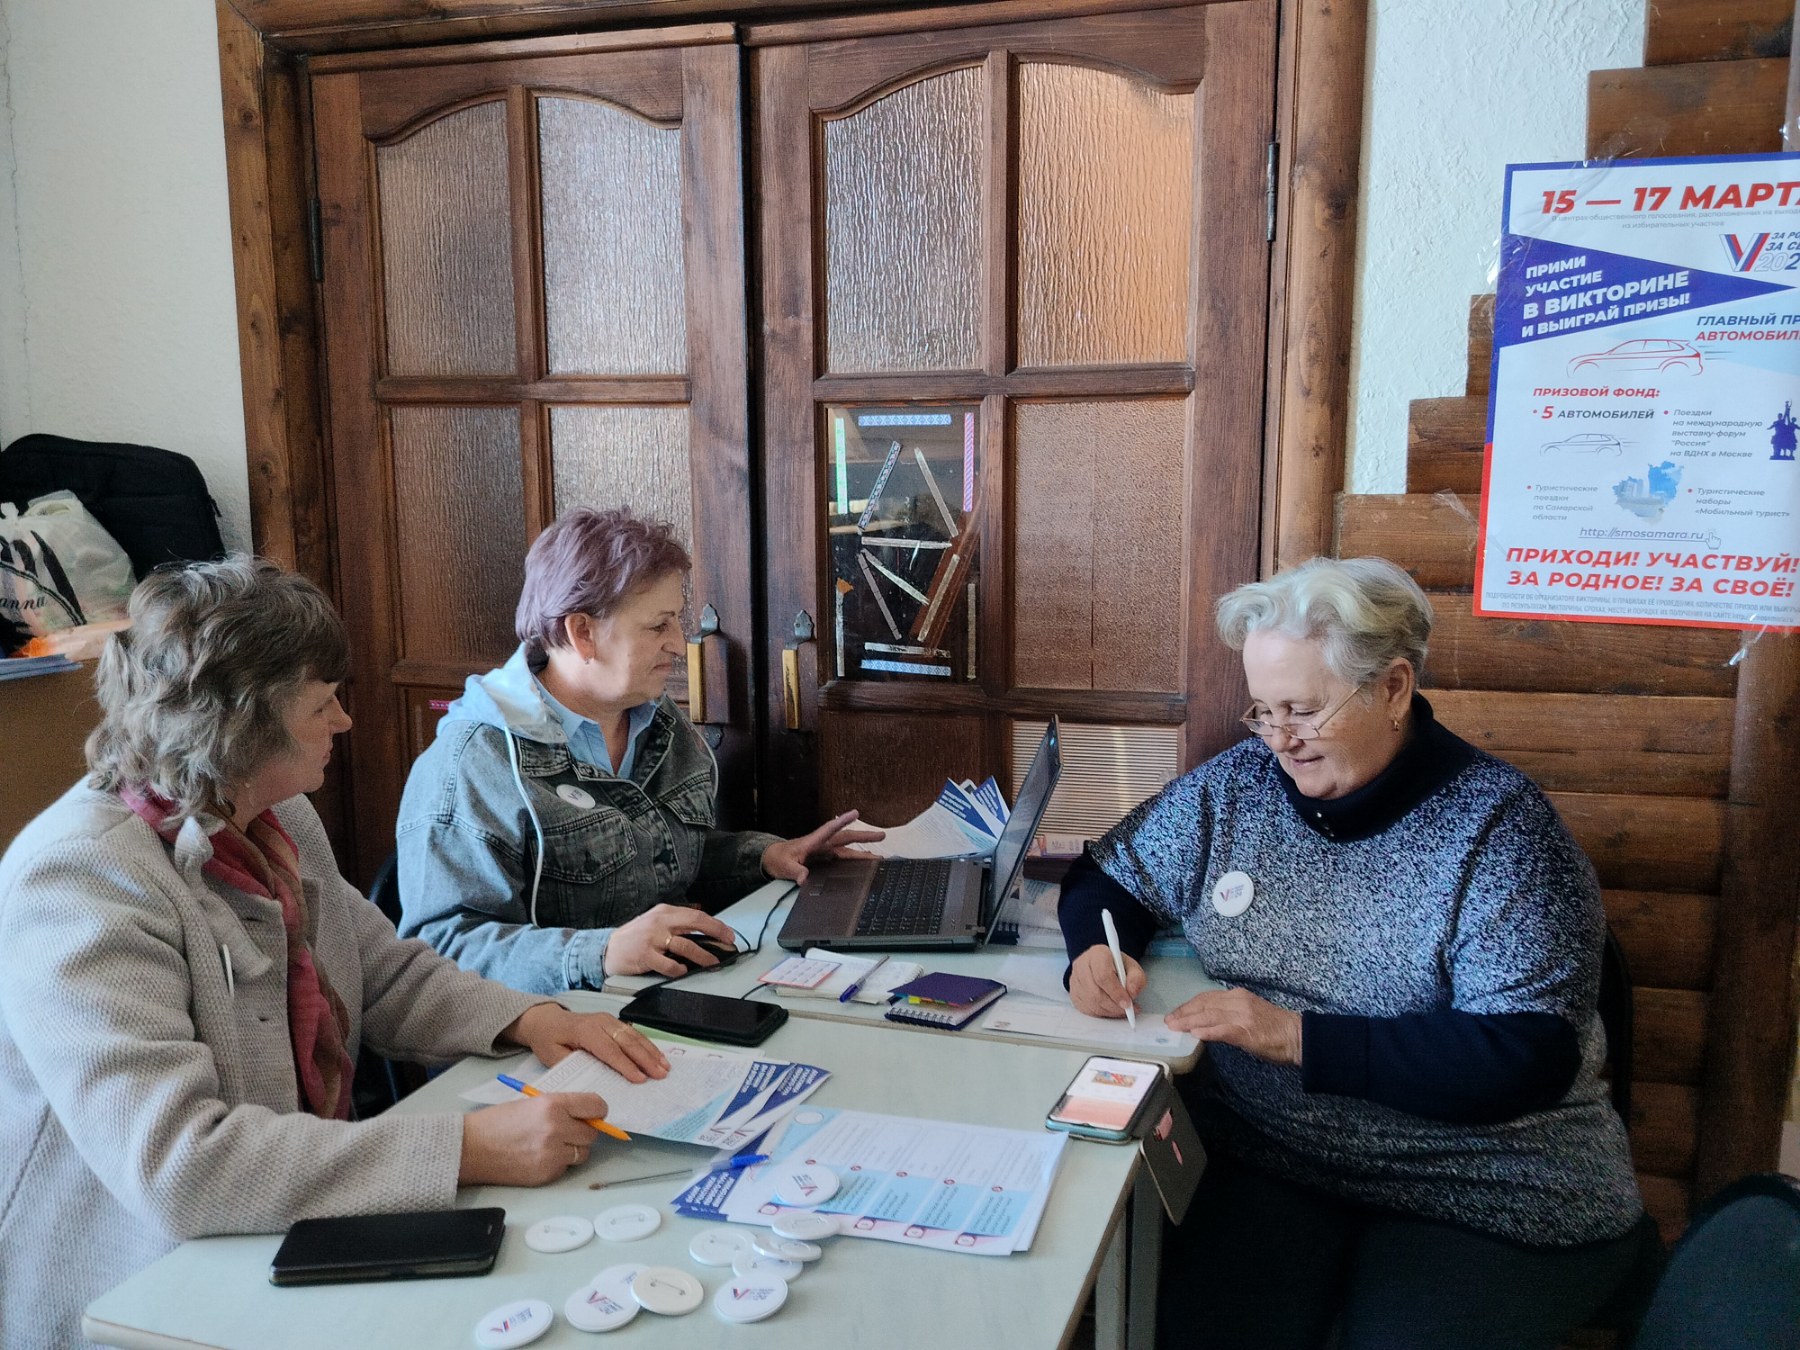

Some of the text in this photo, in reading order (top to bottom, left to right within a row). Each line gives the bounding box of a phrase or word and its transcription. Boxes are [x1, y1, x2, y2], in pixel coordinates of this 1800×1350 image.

[1541, 189, 1577, 214] 15
[1633, 186, 1672, 212] 17
[1679, 181, 1800, 210] МАРТ
[1771, 232, 1786, 240] ЗА
[1765, 242, 1784, 251] ЗА
[1526, 255, 1586, 279] ПРИМИ
[1525, 270, 1603, 297] УЧАСТИЕ
[1523, 270, 1690, 320] В ВИКТОРИНЕ
[1521, 292, 1691, 338] И ВЫИГРАЙ ПРИЗЫ!
[1696, 312, 1777, 326] ГЛАВНЫЙ
[1695, 330, 1800, 342] АВТОМОБИЛ
[1532, 385, 1660, 398] ПРИЗОВОЙ ФОНД:
[1541, 405, 1655, 420] 5 АВТОМОБИЛЕЙ
[1673, 408, 1712, 417] Поездки
[1686, 419, 1763, 429] международную
[1671, 429, 1747, 439] выставку-форум
[1683, 450, 1709, 458] ВДНХ
[1718, 450, 1753, 458] Москве
[1535, 484, 1599, 493] Туристические
[1697, 487, 1766, 497] Туристические
[1533, 494, 1570, 502] поездки
[1695, 497, 1732, 506] наборы
[1545, 503, 1594, 513] Самарской
[1532, 513, 1568, 521] области
[1580, 527, 1704, 540] http://smosamara.ru
[1505, 547, 1800, 573] ПРИХОДИ! УЧАСТВУЙ!
[1507, 570, 1795, 598] ЗА РОДНОЕ! ЗА СВОЁ!
